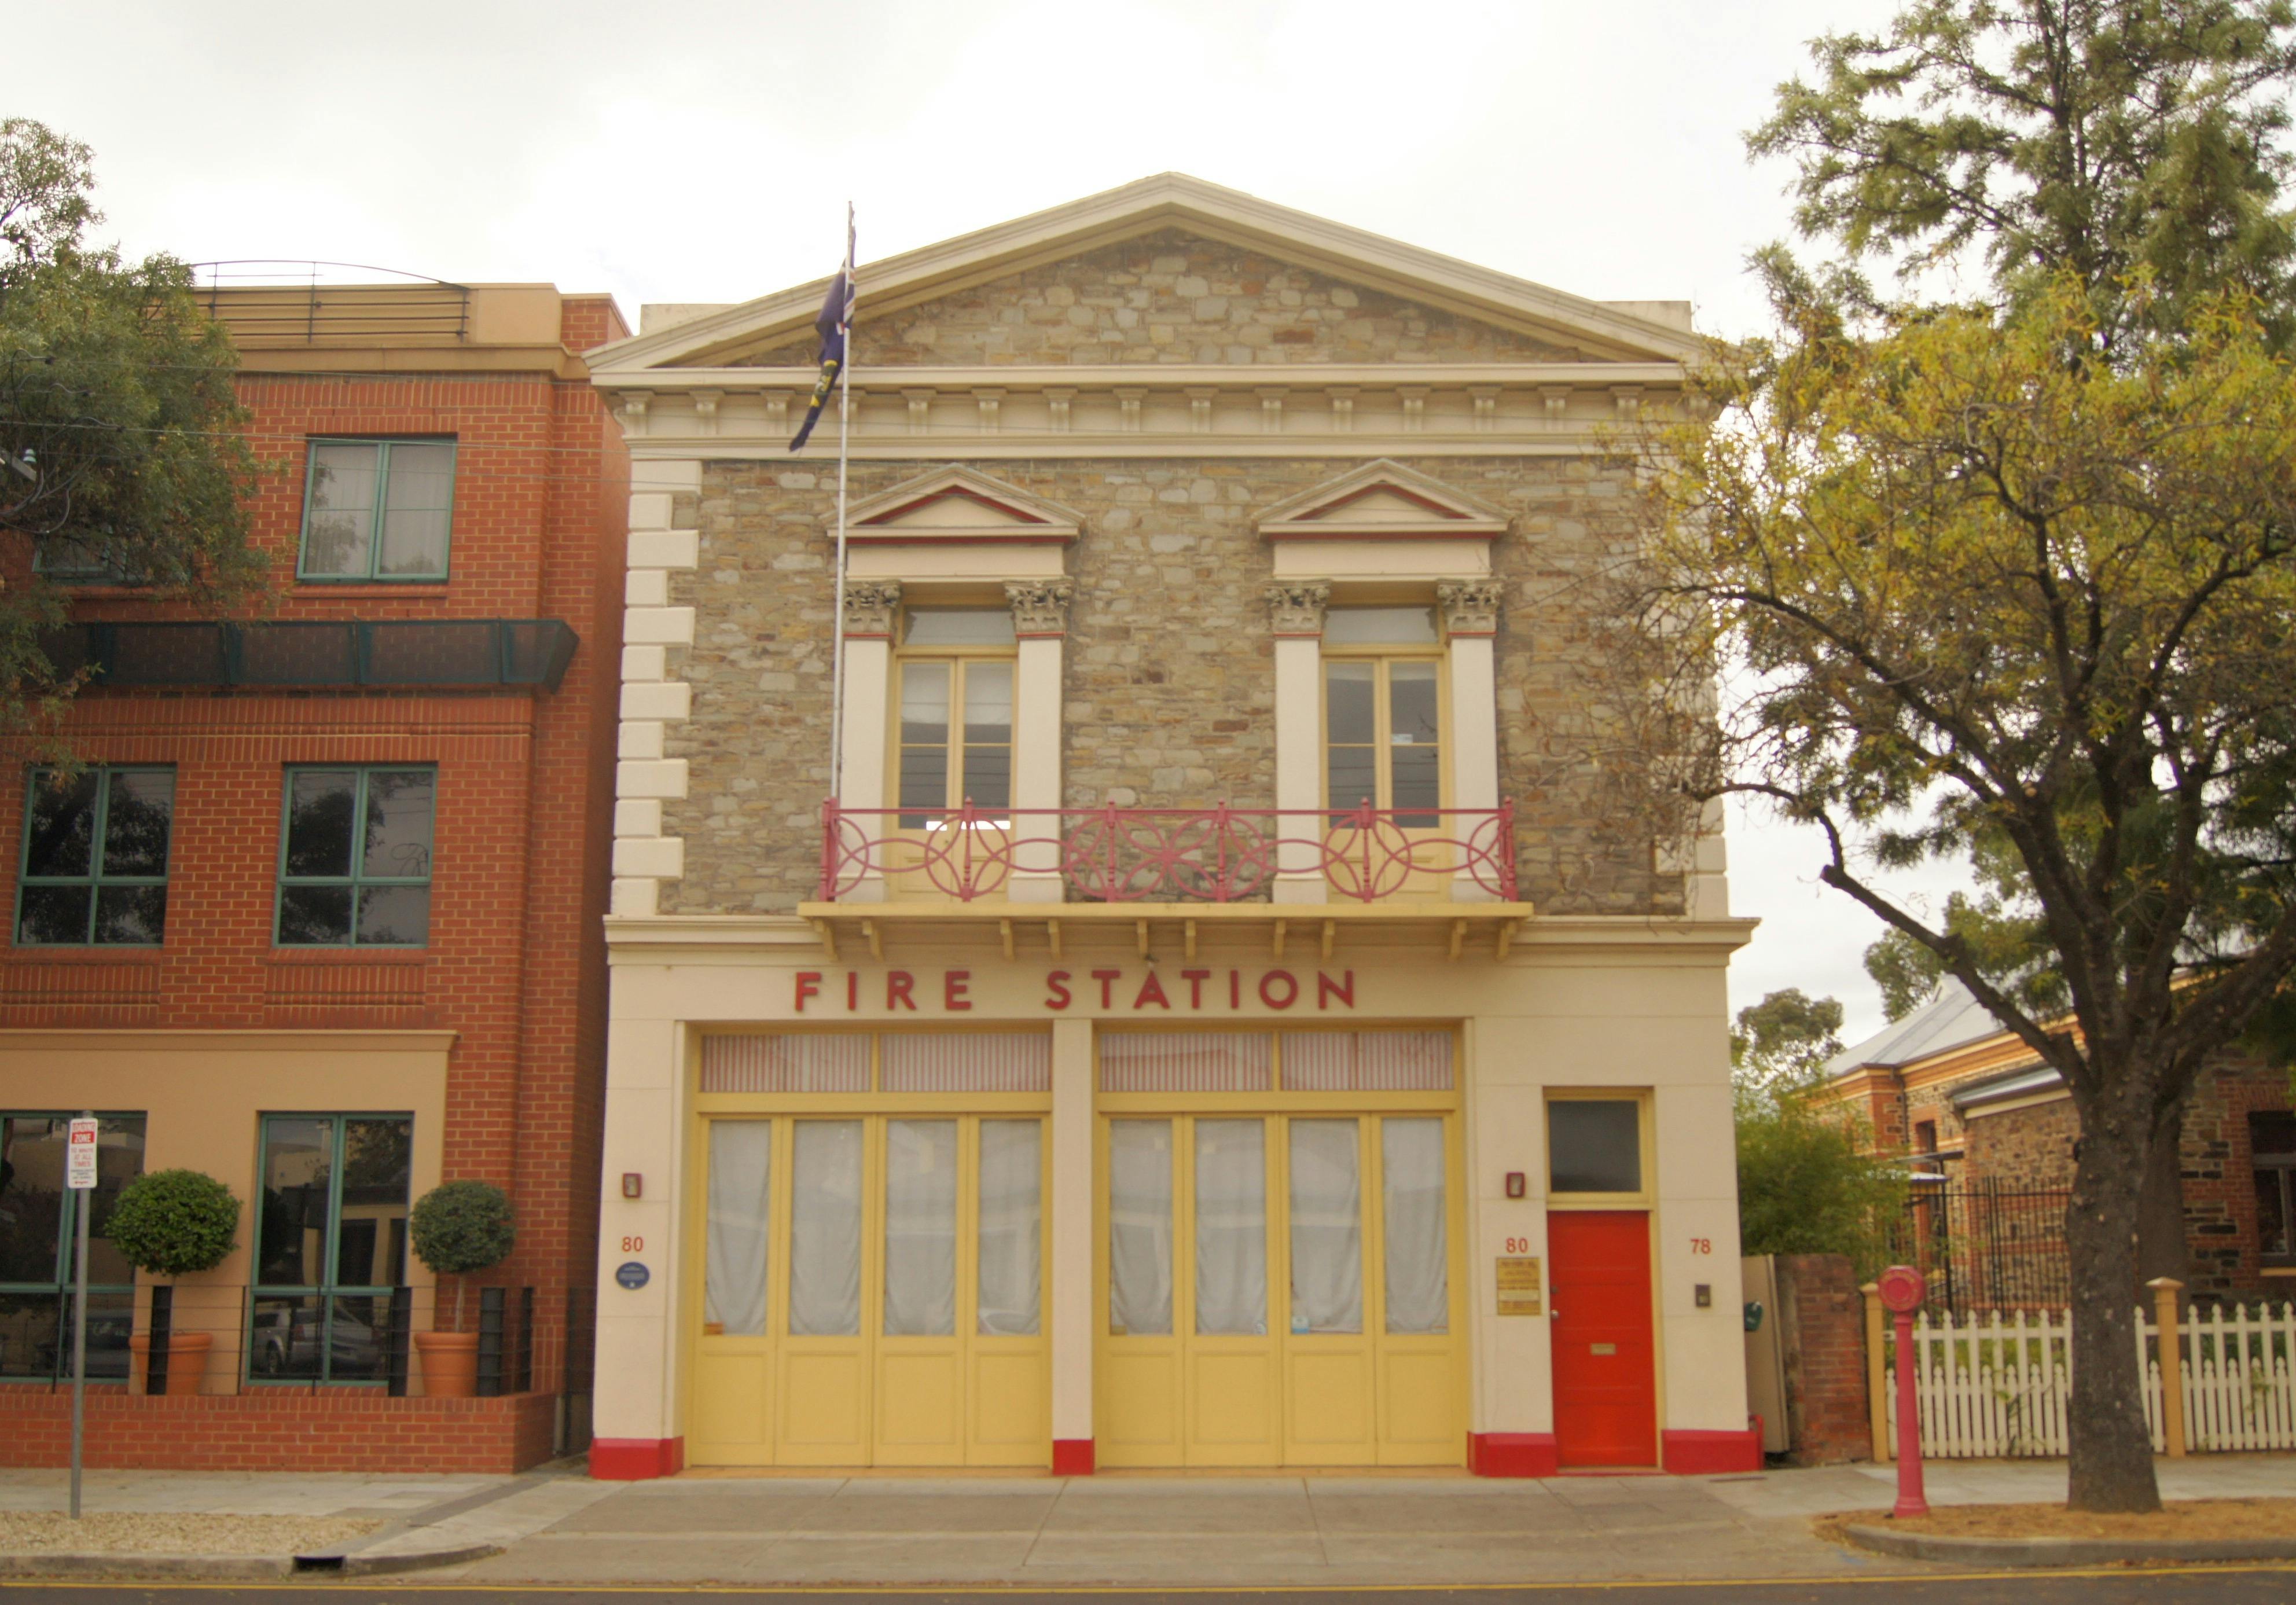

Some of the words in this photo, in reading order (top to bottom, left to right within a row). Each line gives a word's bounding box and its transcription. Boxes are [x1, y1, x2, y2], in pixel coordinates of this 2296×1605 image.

[795, 971, 972, 1011] FIRE
[1044, 969, 1355, 1011] STATION
[74, 1133, 91, 1143] ZONE
[622, 1236, 644, 1252] 80
[1506, 1237, 1528, 1253] 80
[1690, 1239, 1711, 1255] 78
